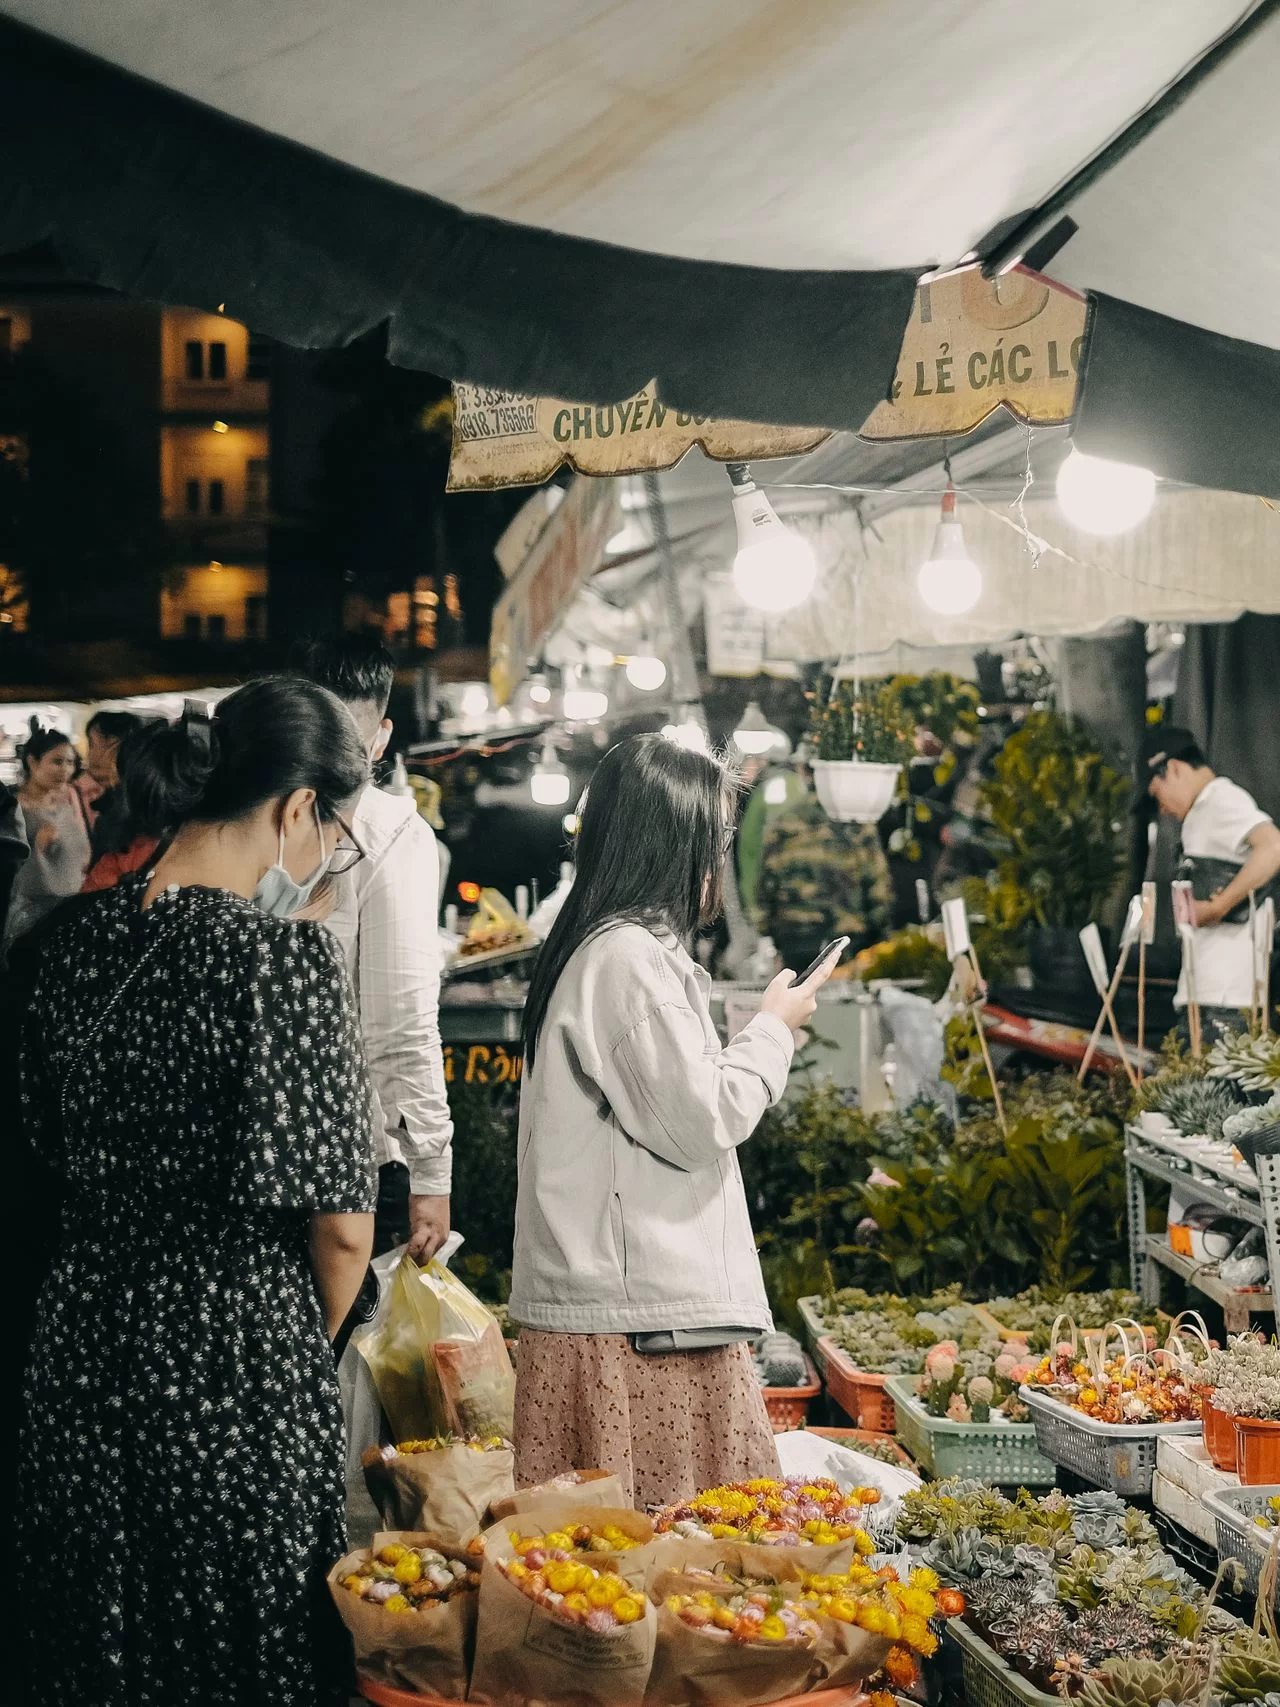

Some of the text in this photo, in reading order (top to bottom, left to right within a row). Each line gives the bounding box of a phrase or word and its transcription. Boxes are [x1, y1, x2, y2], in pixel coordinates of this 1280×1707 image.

[913, 342, 955, 397] LẺ
[968, 337, 1032, 390] CÁC
[460, 404, 534, 439] 0918.735566
[553, 391, 666, 443] CHUYÊN
